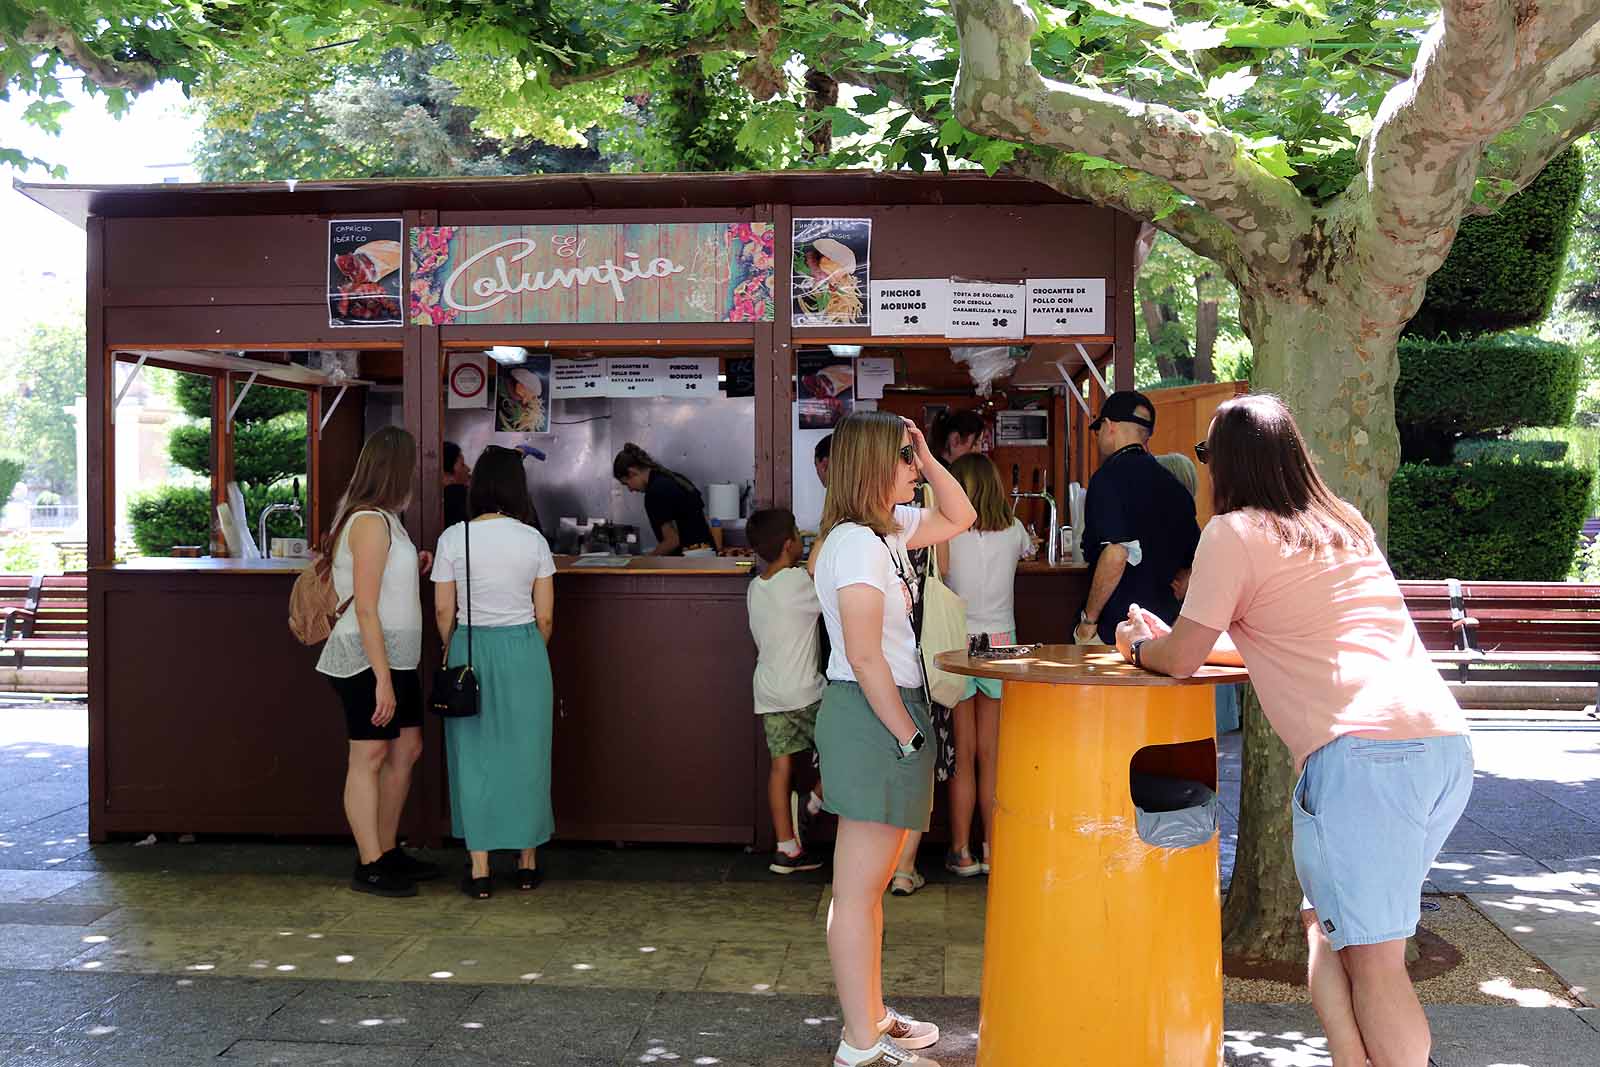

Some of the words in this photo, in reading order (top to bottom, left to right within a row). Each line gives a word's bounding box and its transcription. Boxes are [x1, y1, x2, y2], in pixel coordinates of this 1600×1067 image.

[552, 234, 586, 259] El
[443, 238, 685, 312] Columpio
[880, 289, 921, 298] PINCHOS
[880, 302, 927, 310] MORUNOS
[903, 315, 919, 324] 2€
[992, 318, 1009, 327] 3€
